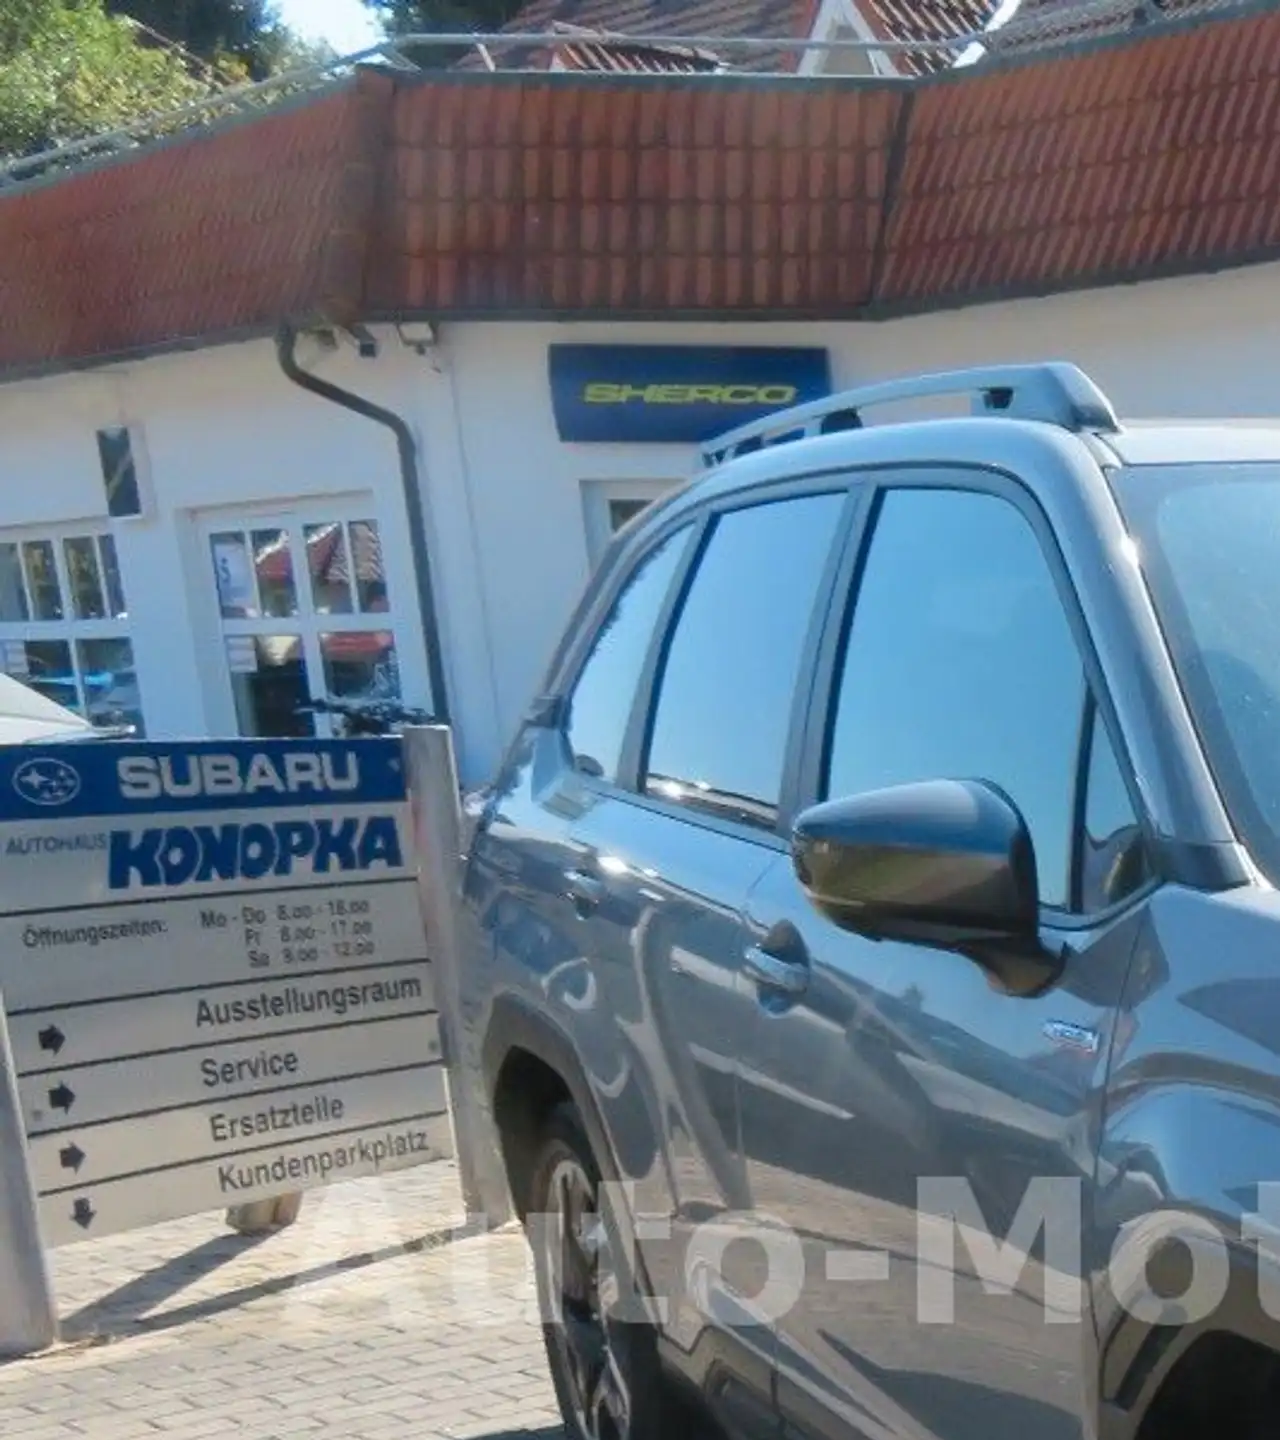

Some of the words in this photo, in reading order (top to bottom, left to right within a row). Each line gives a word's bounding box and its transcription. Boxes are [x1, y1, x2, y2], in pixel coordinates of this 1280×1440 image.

[584, 383, 796, 405] SHERCO
[117, 752, 359, 798] SUBARU
[6, 833, 107, 855] AUTOHAUS
[108, 816, 404, 889] KONOPKA
[23, 918, 168, 949] Öffnungszeiten:
[200, 910, 227, 928] Mo
[242, 906, 266, 925] Do
[245, 928, 261, 946] Fr
[196, 975, 422, 1027] Ausstellungsraum
[200, 1049, 299, 1088] Service
[209, 1095, 344, 1142] Ersatzteile
[217, 1126, 429, 1193] Kundenparkplatz
